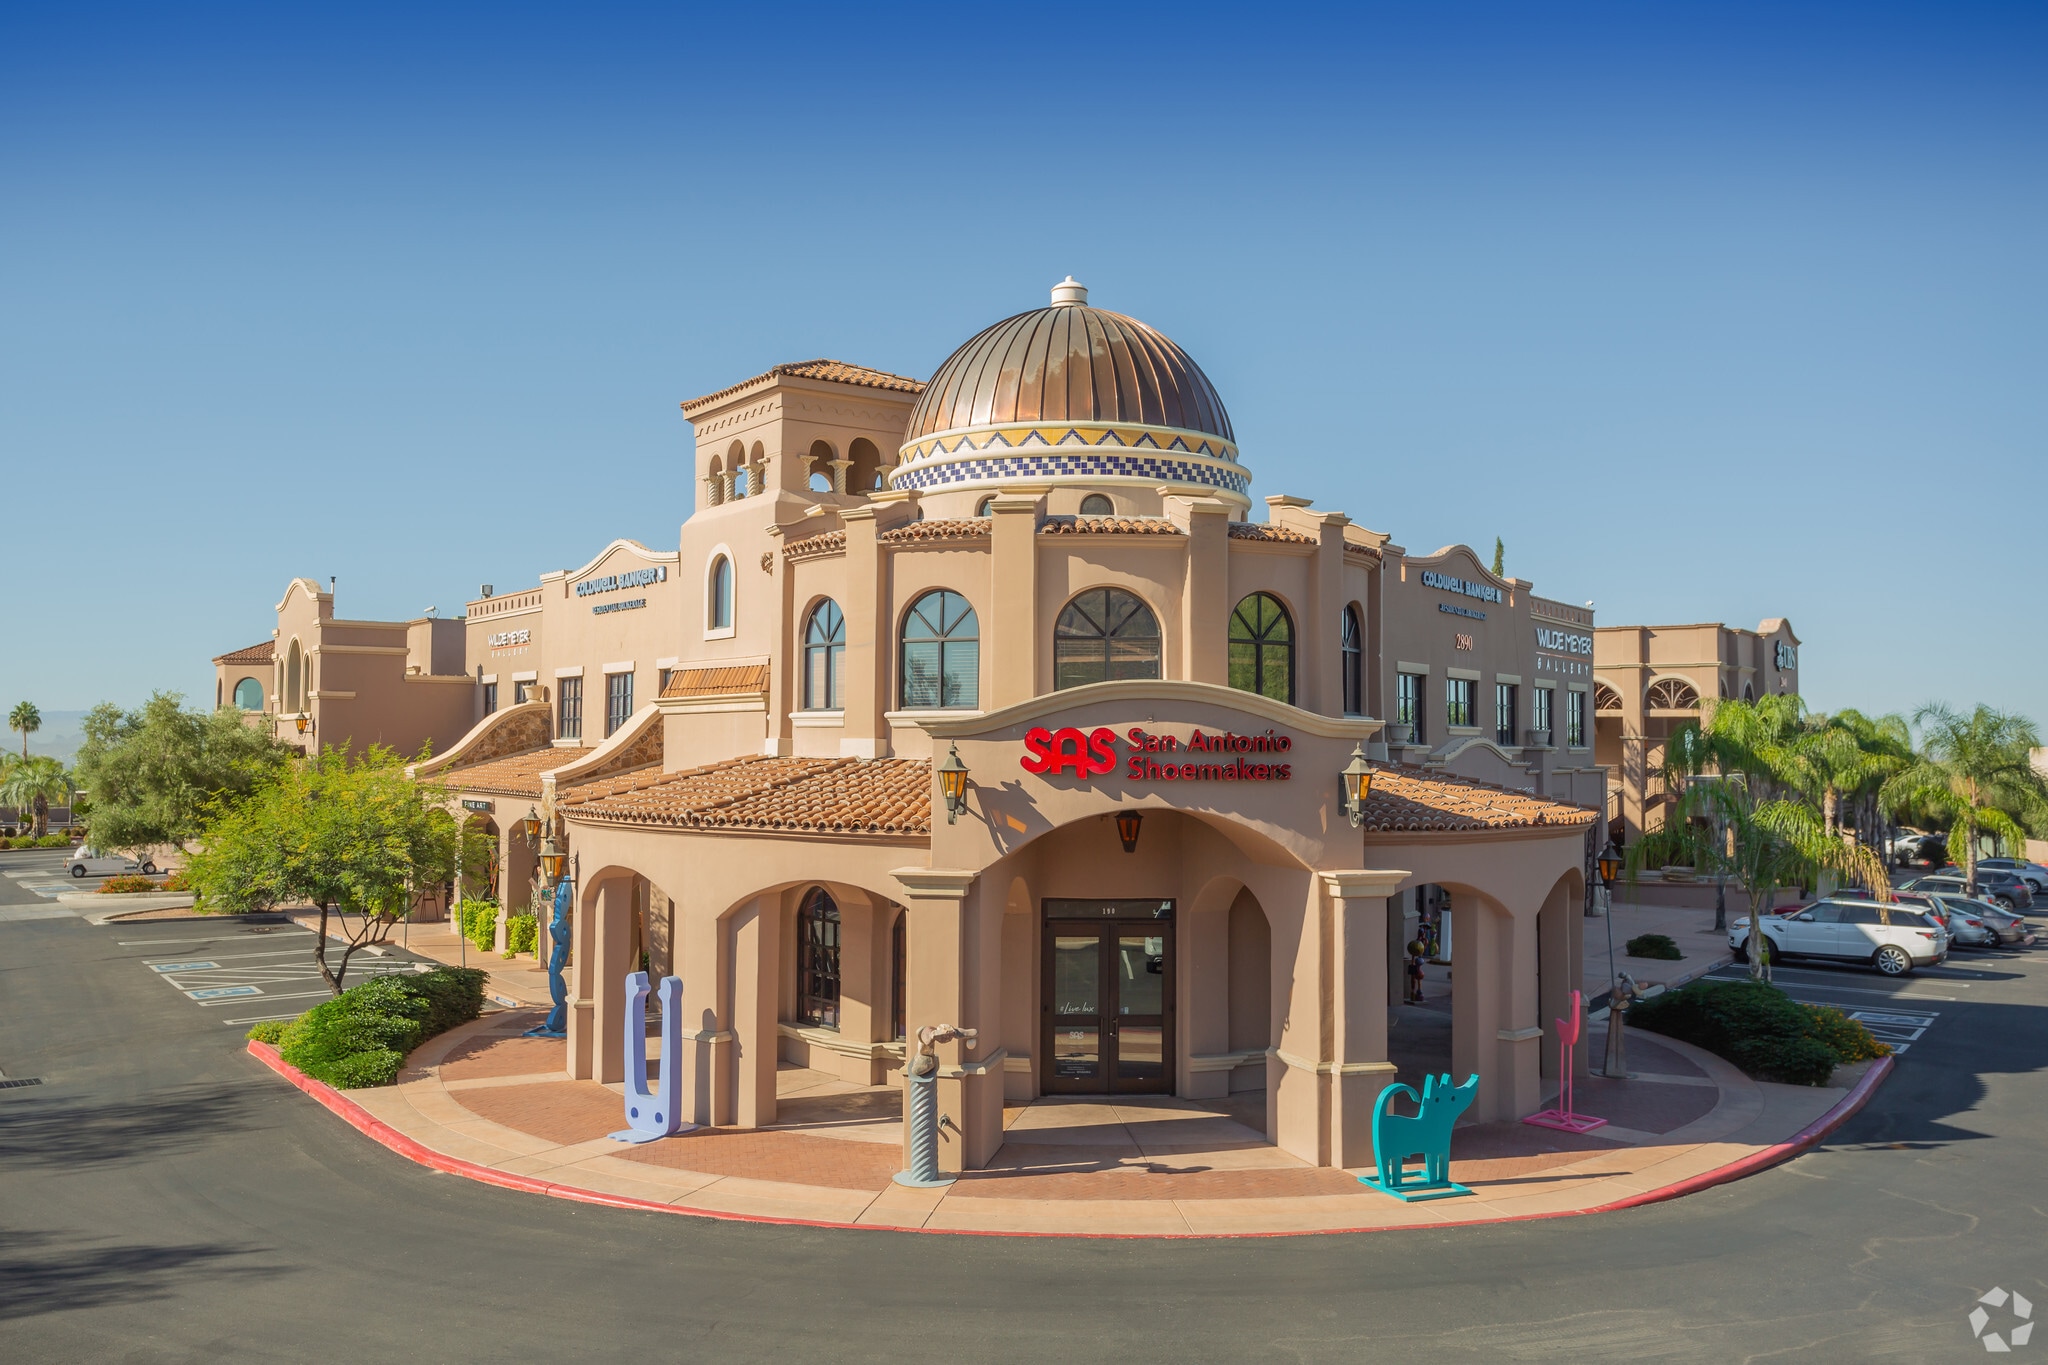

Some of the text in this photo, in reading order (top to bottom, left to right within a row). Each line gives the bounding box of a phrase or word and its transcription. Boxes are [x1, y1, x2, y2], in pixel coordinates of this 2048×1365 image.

[1422, 571, 1464, 594] COLDWELL
[1464, 581, 1496, 602] BANKER
[1455, 633, 1473, 651] 2890
[1536, 627, 1592, 655] WILDE MEYER
[1537, 657, 1589, 676] GALLERY
[1127, 728, 1292, 753] San Antonio
[1020, 727, 1117, 780] SAS
[1127, 756, 1292, 781] Shoemakers
[1069, 1031, 1084, 1040] SAS
